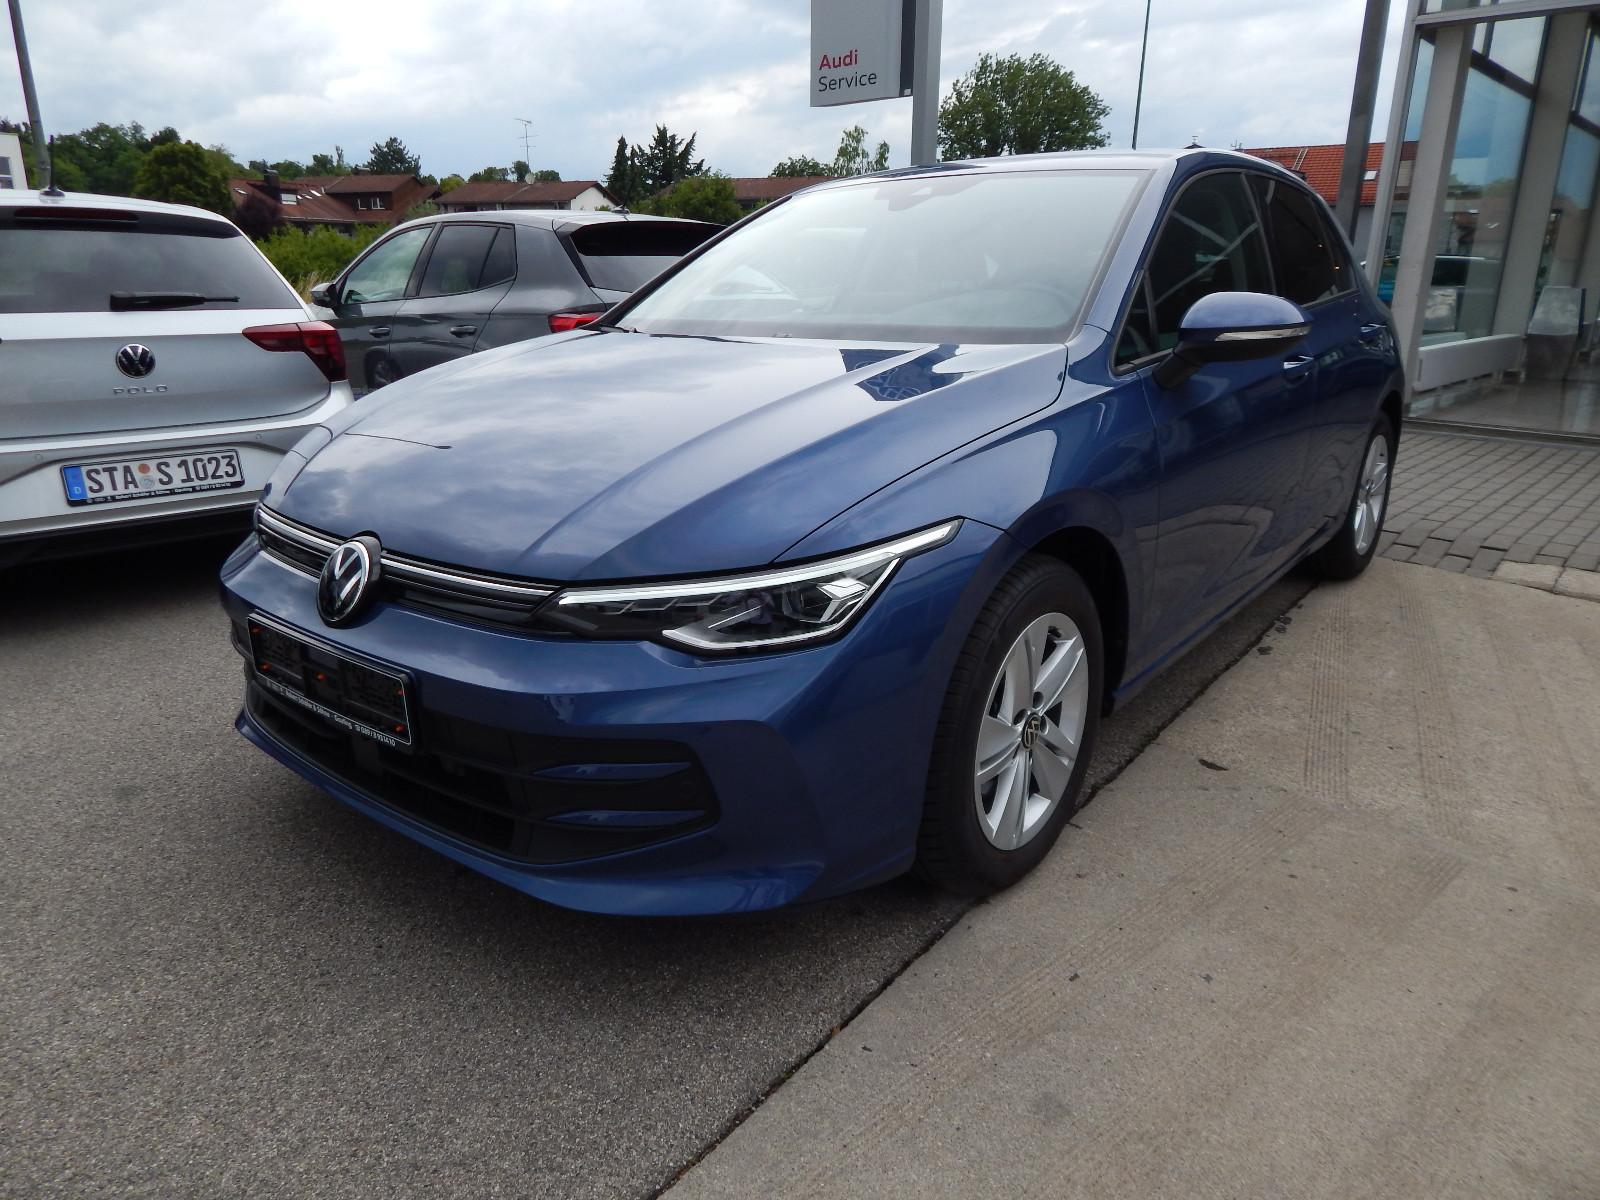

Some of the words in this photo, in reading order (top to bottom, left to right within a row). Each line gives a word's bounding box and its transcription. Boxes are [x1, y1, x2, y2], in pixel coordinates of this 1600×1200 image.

[818, 49, 858, 71] Audi
[818, 71, 877, 92] Service
[113, 384, 168, 395] POLO
[86, 465, 139, 494] STA
[156, 461, 173, 485] S
[177, 454, 238, 483] 1023
